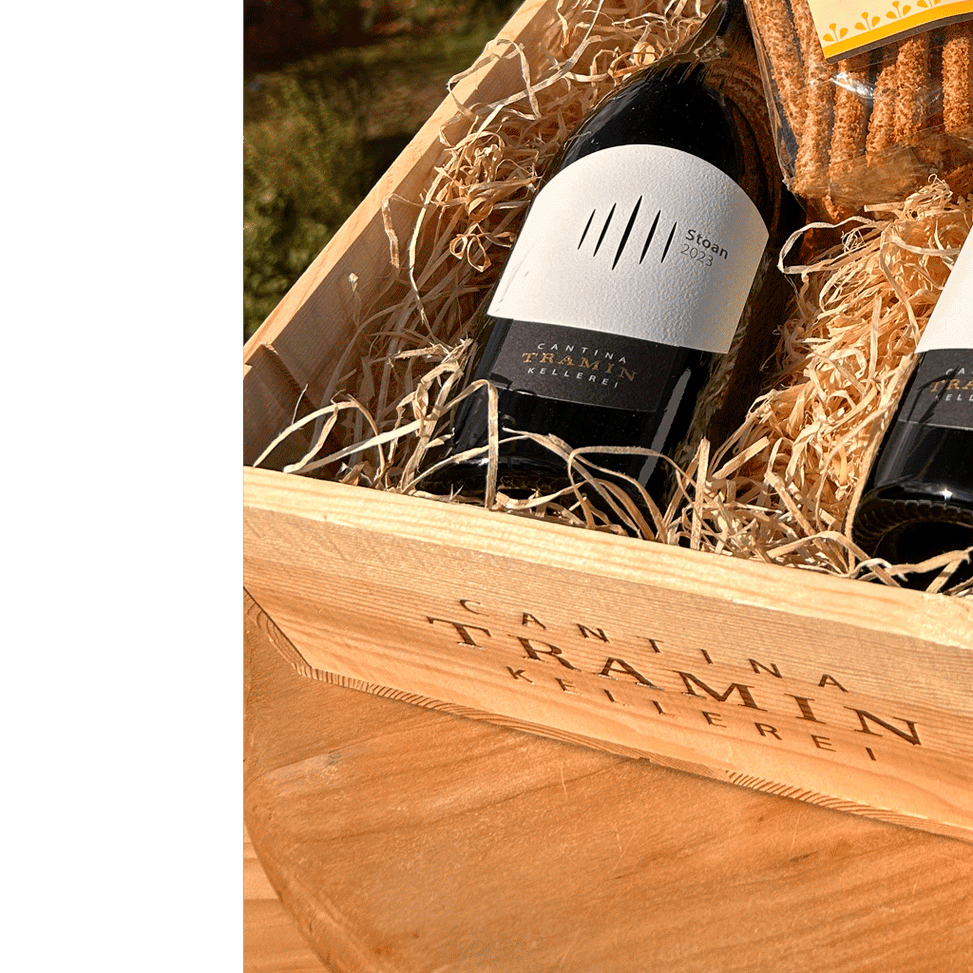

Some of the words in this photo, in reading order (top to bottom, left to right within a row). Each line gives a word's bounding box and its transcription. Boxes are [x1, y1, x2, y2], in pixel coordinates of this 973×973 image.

[680, 243, 715, 267] 2023
[685, 228, 729, 260] Stoan
[521, 352, 637, 382] TRAMIN
[537, 342, 627, 365] CANTINA
[527, 367, 620, 389] KELLEREI
[459, 598, 848, 693] CANTINA
[427, 616, 922, 746] TRAMIN
[506, 665, 877, 762] KELLEREI
